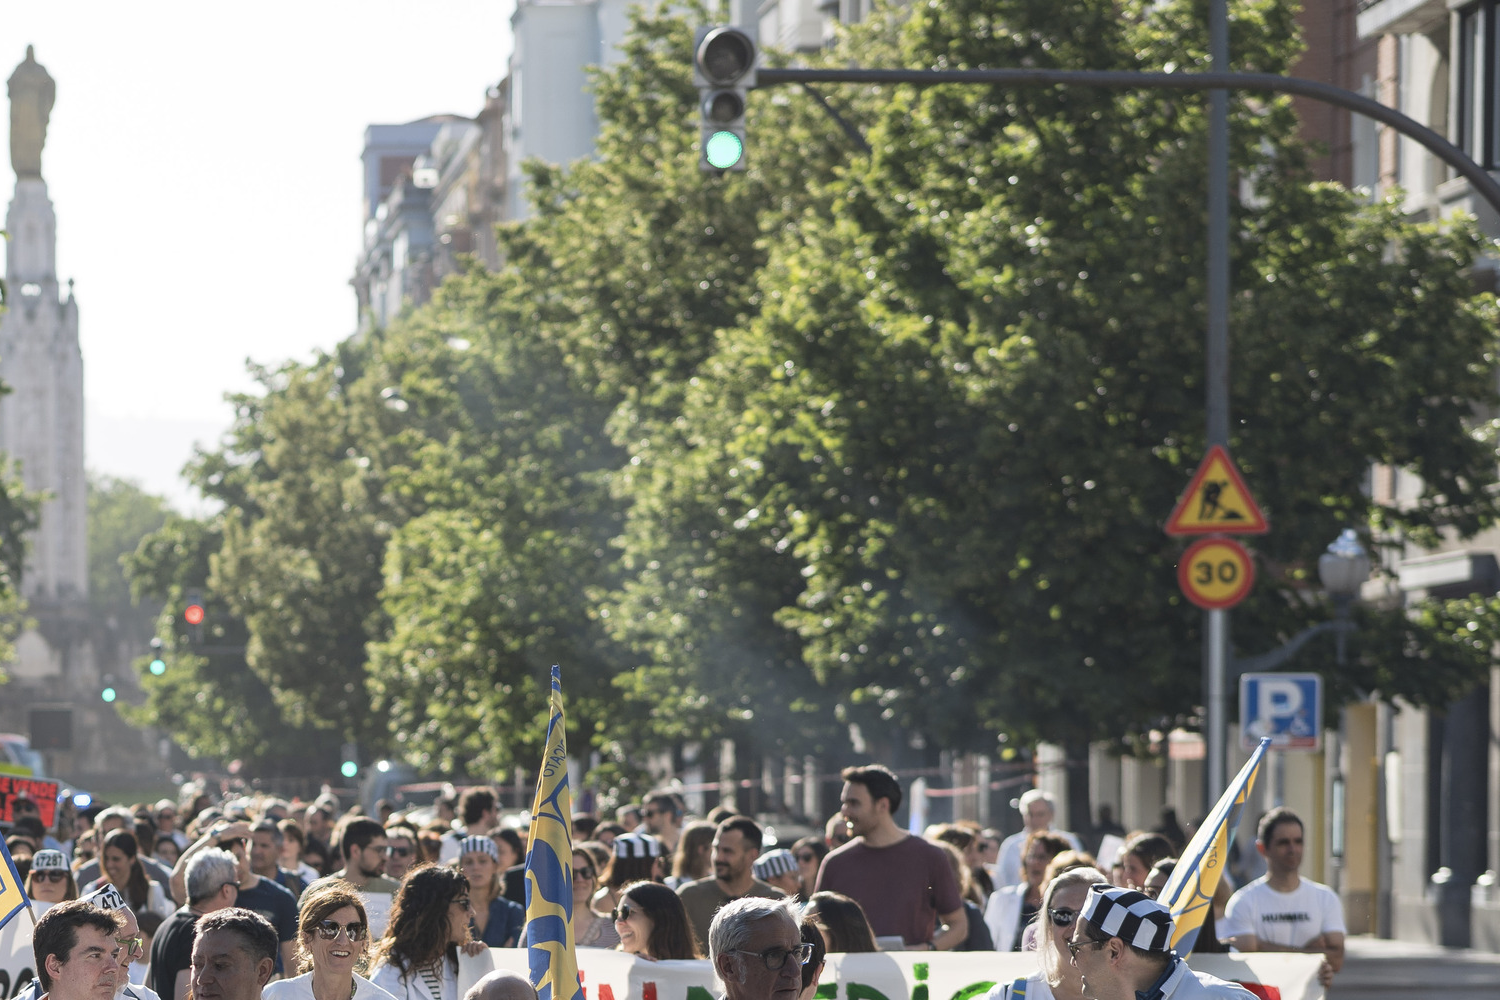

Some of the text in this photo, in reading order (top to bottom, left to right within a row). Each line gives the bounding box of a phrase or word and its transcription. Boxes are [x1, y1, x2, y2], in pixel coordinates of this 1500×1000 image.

[1195, 559, 1239, 587] 30
[1258, 680, 1303, 728] P
[35, 855, 63, 868] 47287
